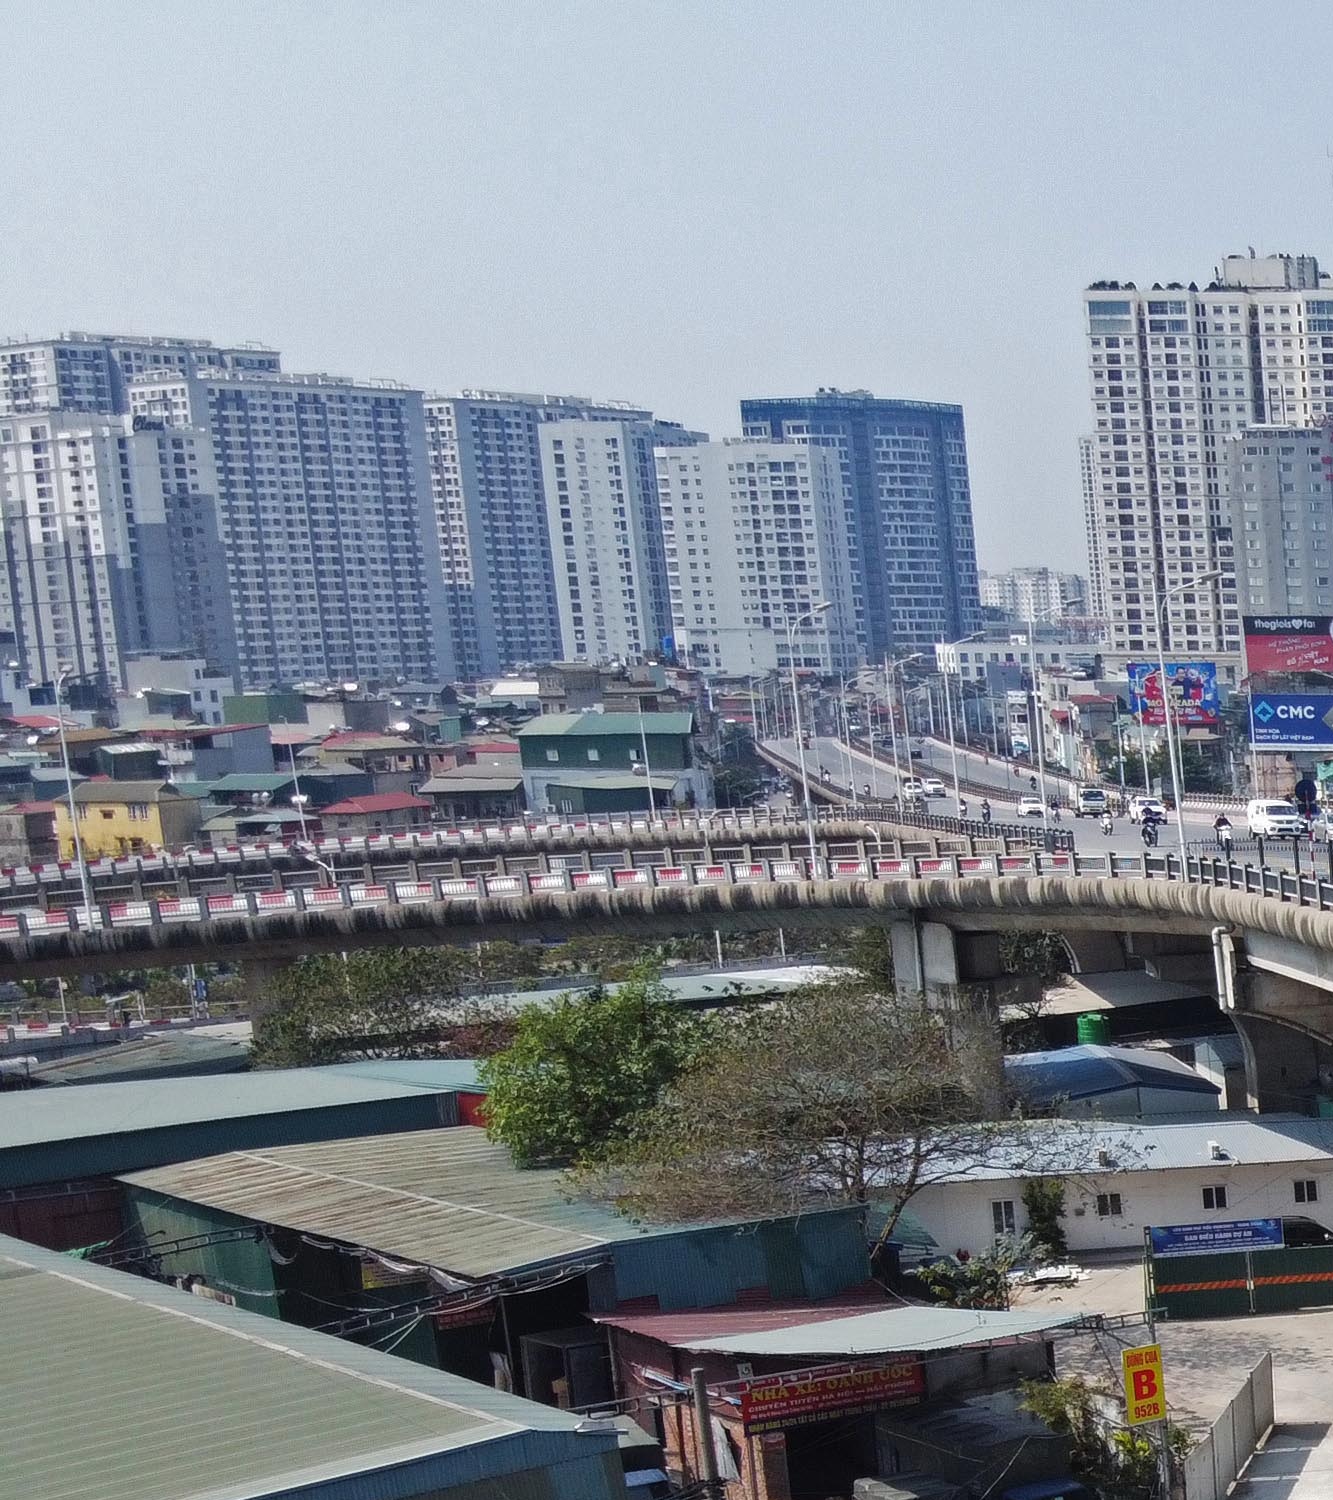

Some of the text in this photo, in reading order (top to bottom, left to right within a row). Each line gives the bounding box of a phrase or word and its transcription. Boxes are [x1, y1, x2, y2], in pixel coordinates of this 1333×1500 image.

[1276, 705, 1315, 719] CMC
[1133, 1369, 1158, 1401] B
[1134, 1402, 1160, 1419] 952B
